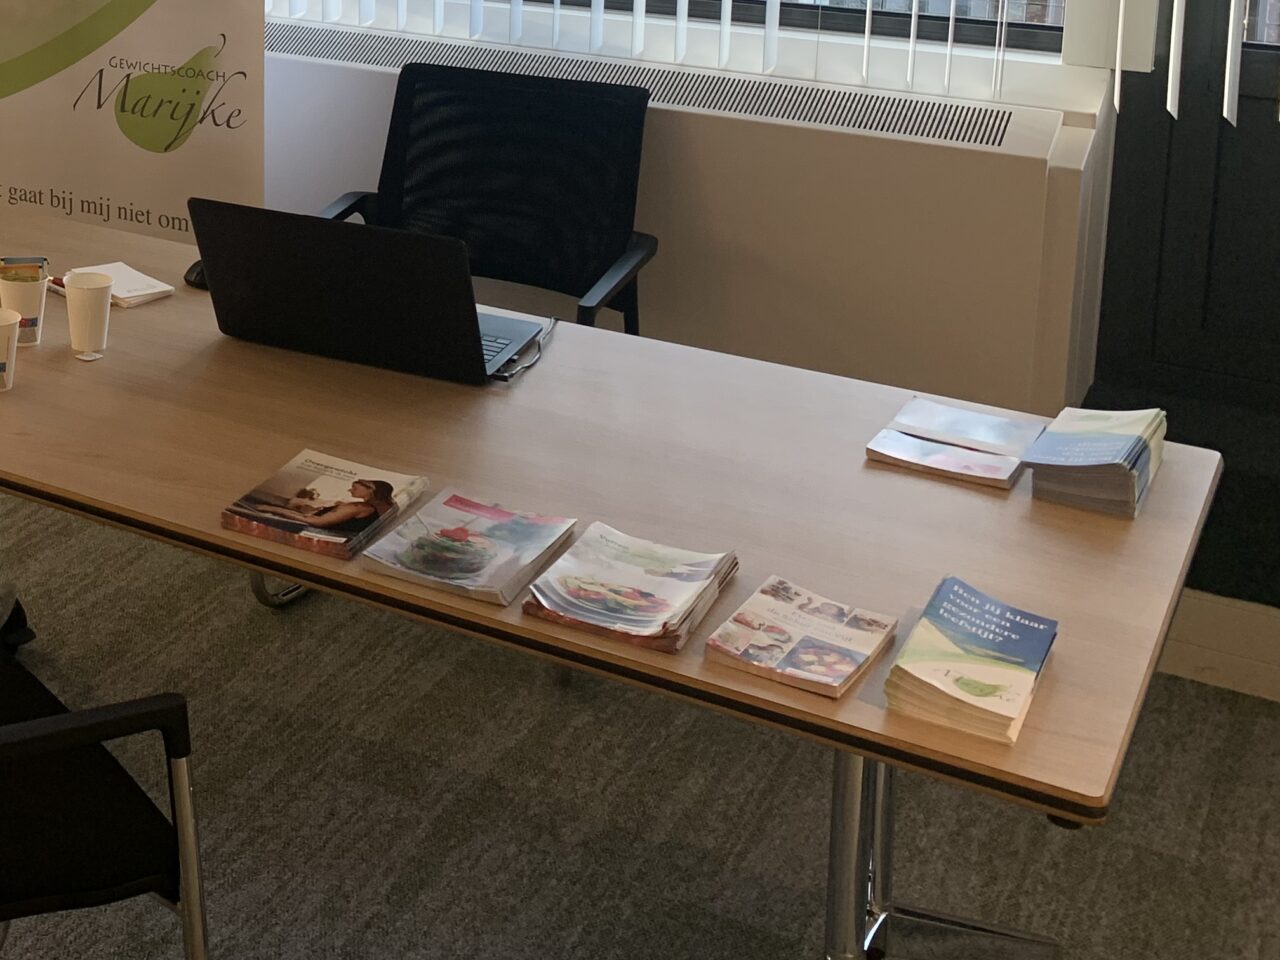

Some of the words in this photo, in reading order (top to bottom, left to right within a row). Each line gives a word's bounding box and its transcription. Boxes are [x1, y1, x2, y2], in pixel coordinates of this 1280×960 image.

[108, 55, 226, 82] GEWICHTSCOACH
[73, 67, 248, 152] Marijke
[8, 186, 44, 206] gaat
[50, 188, 74, 216] bij
[80, 197, 111, 222] mij
[117, 203, 152, 225] niet
[158, 214, 190, 232] om
[953, 584, 980, 604] Ben
[1005, 611, 1048, 630] klaar
